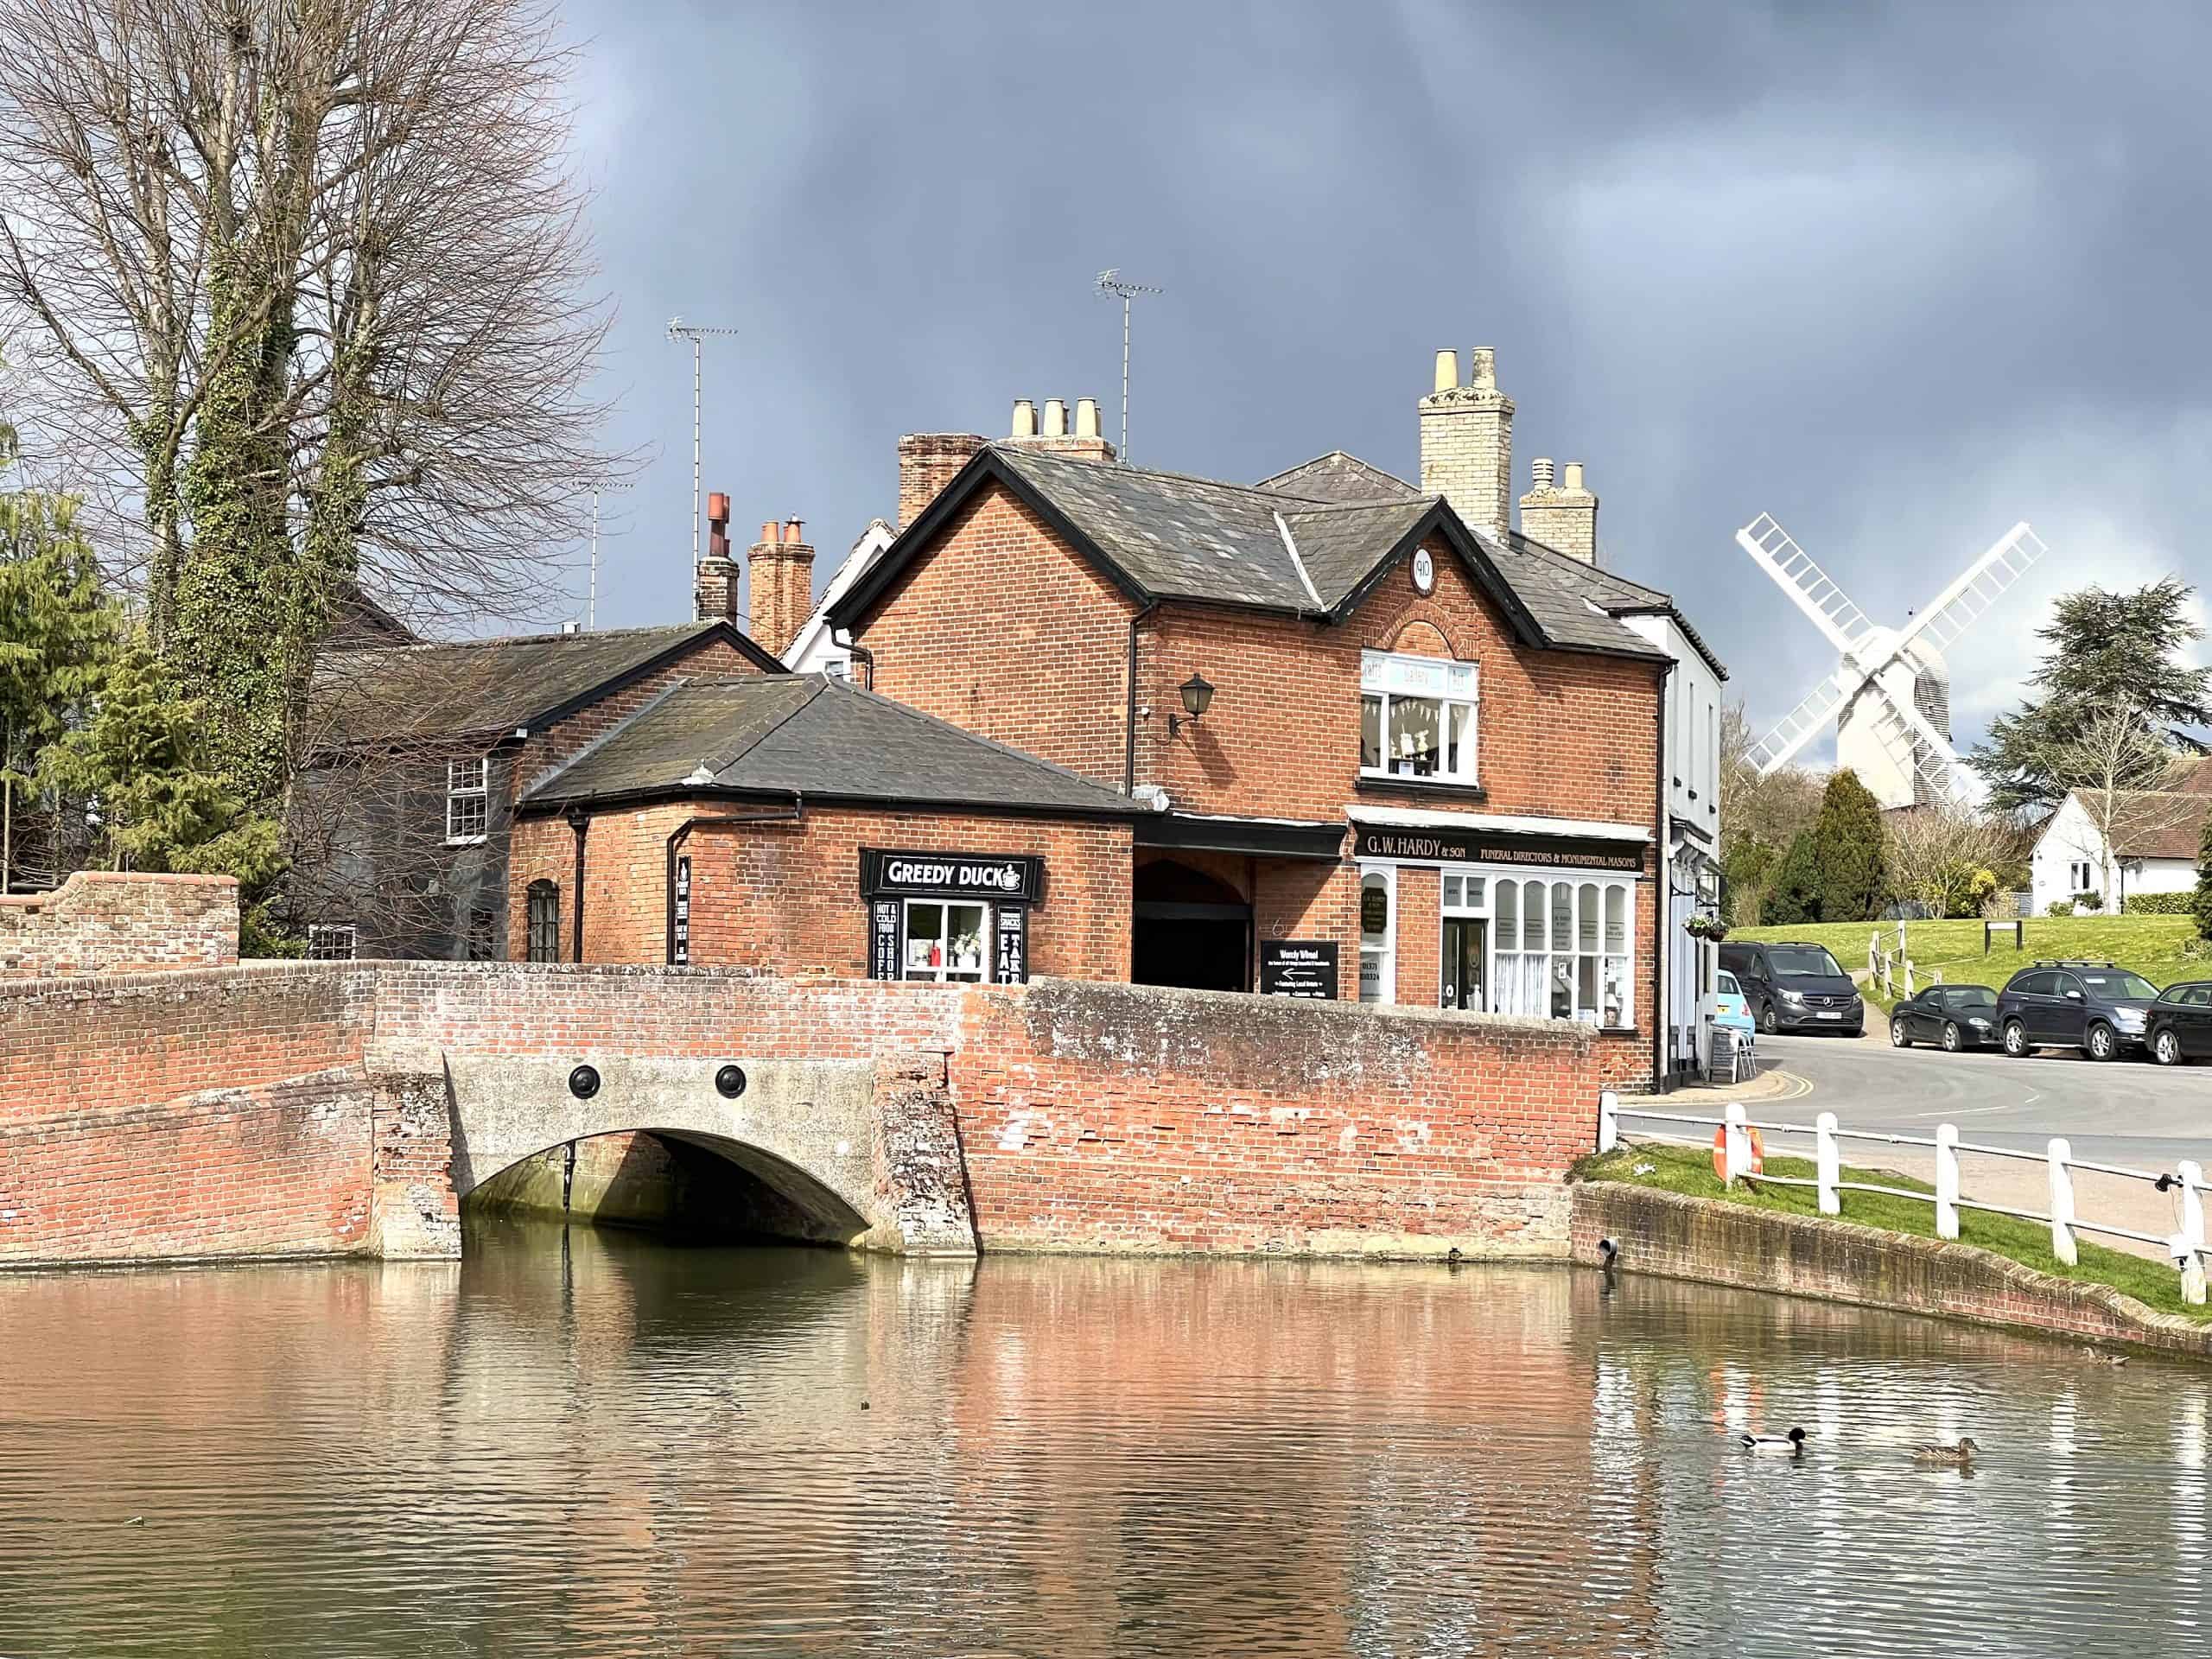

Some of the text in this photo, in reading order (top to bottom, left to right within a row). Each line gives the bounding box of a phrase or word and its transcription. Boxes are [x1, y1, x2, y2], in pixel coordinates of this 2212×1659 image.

[1398, 837, 1441, 856] HARDY
[1449, 847, 1466, 858] SON
[1480, 849, 1512, 861] FUNERAL
[1513, 851, 1552, 863] DIRECTORS
[1560, 854, 1608, 866] MONUMENTAL
[1608, 856, 1636, 868] MASONS
[888, 861, 1004, 887] GREEDY DUCK
